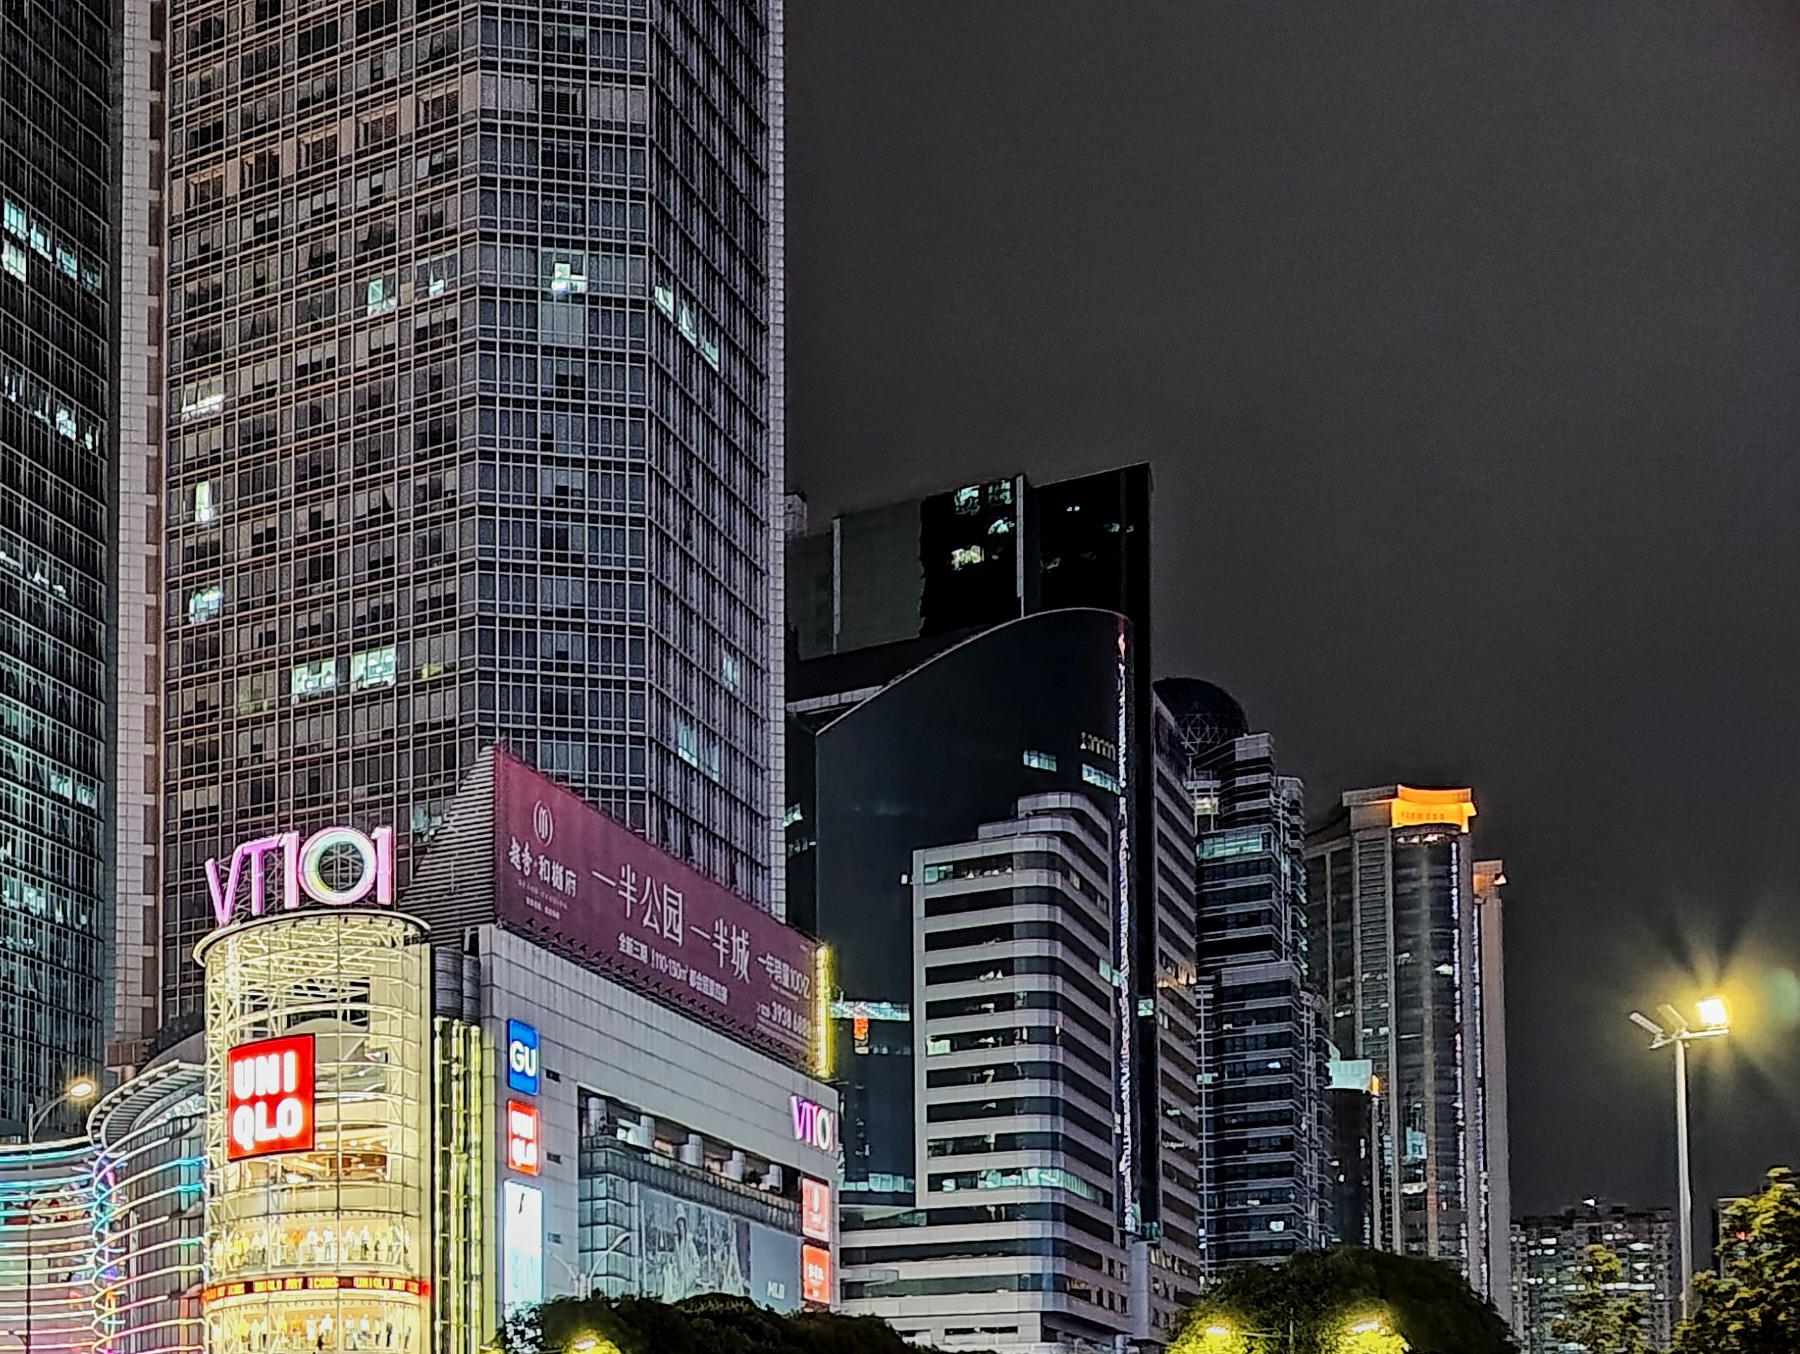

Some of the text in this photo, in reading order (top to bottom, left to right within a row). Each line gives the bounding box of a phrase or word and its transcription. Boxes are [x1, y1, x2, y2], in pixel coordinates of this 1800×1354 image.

[204, 825, 393, 928] VT101
[591, 863, 683, 948] 一半公园
[689, 918, 750, 984] 一半城
[232, 1050, 297, 1101] UNI
[510, 1040, 536, 1077] GU
[232, 1097, 304, 1151] QLO
